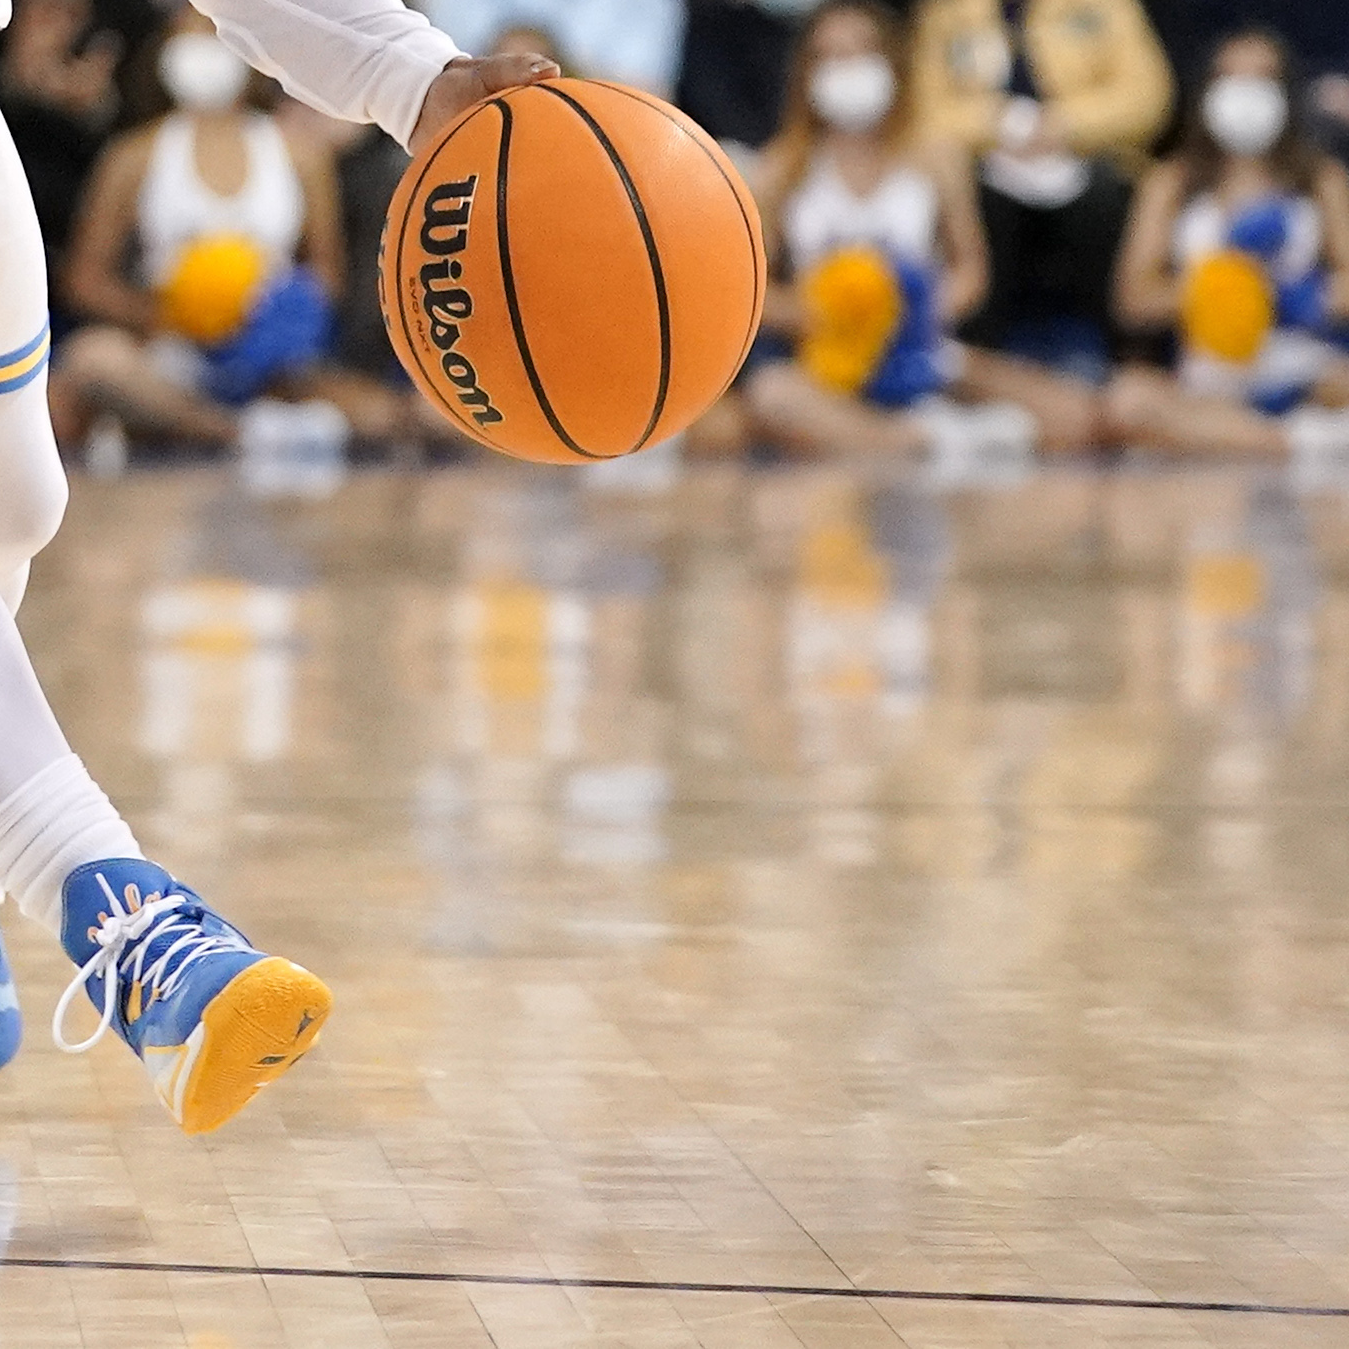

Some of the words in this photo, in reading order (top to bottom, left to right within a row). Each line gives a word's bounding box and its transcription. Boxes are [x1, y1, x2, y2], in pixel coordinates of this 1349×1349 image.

[408, 276, 420, 314] EVO
[416, 319, 432, 353] NXT
[419, 172, 505, 428] Wilson
